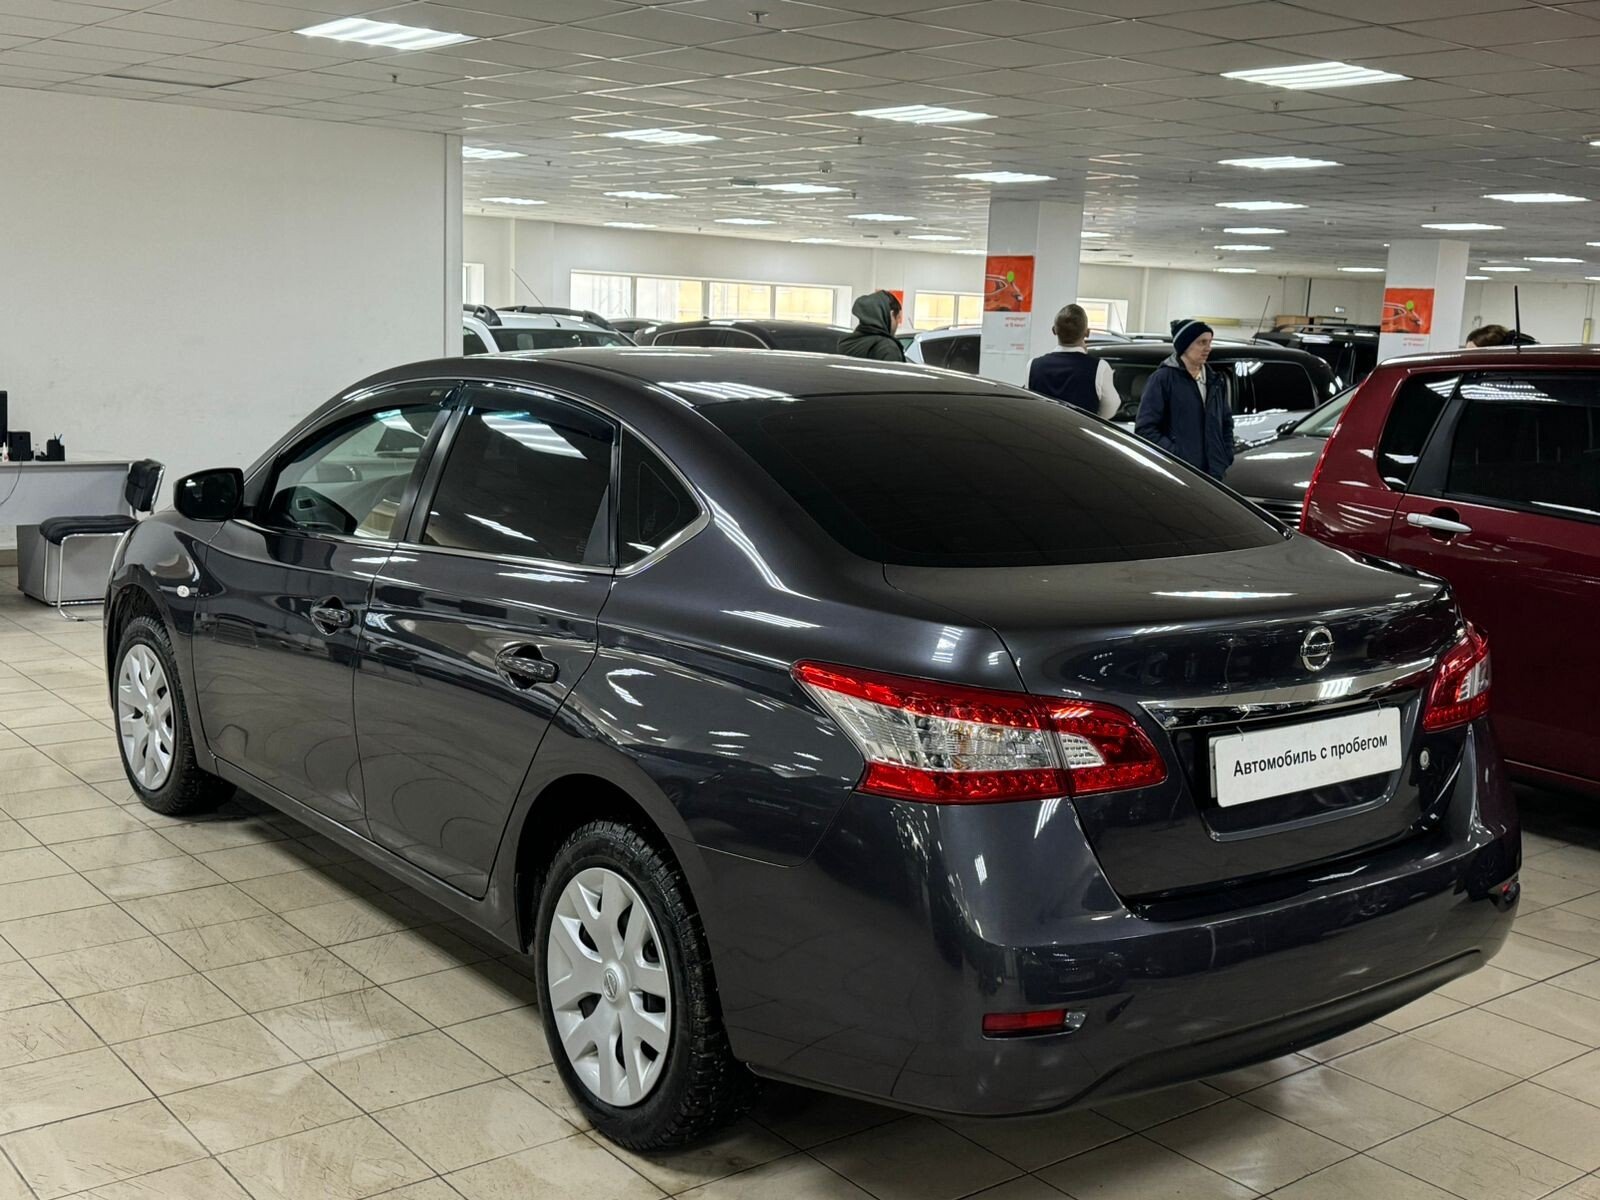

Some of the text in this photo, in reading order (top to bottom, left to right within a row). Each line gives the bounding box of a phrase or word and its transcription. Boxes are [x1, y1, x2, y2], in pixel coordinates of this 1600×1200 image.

[1233, 734, 1388, 777] Автомобиль с пробегом
